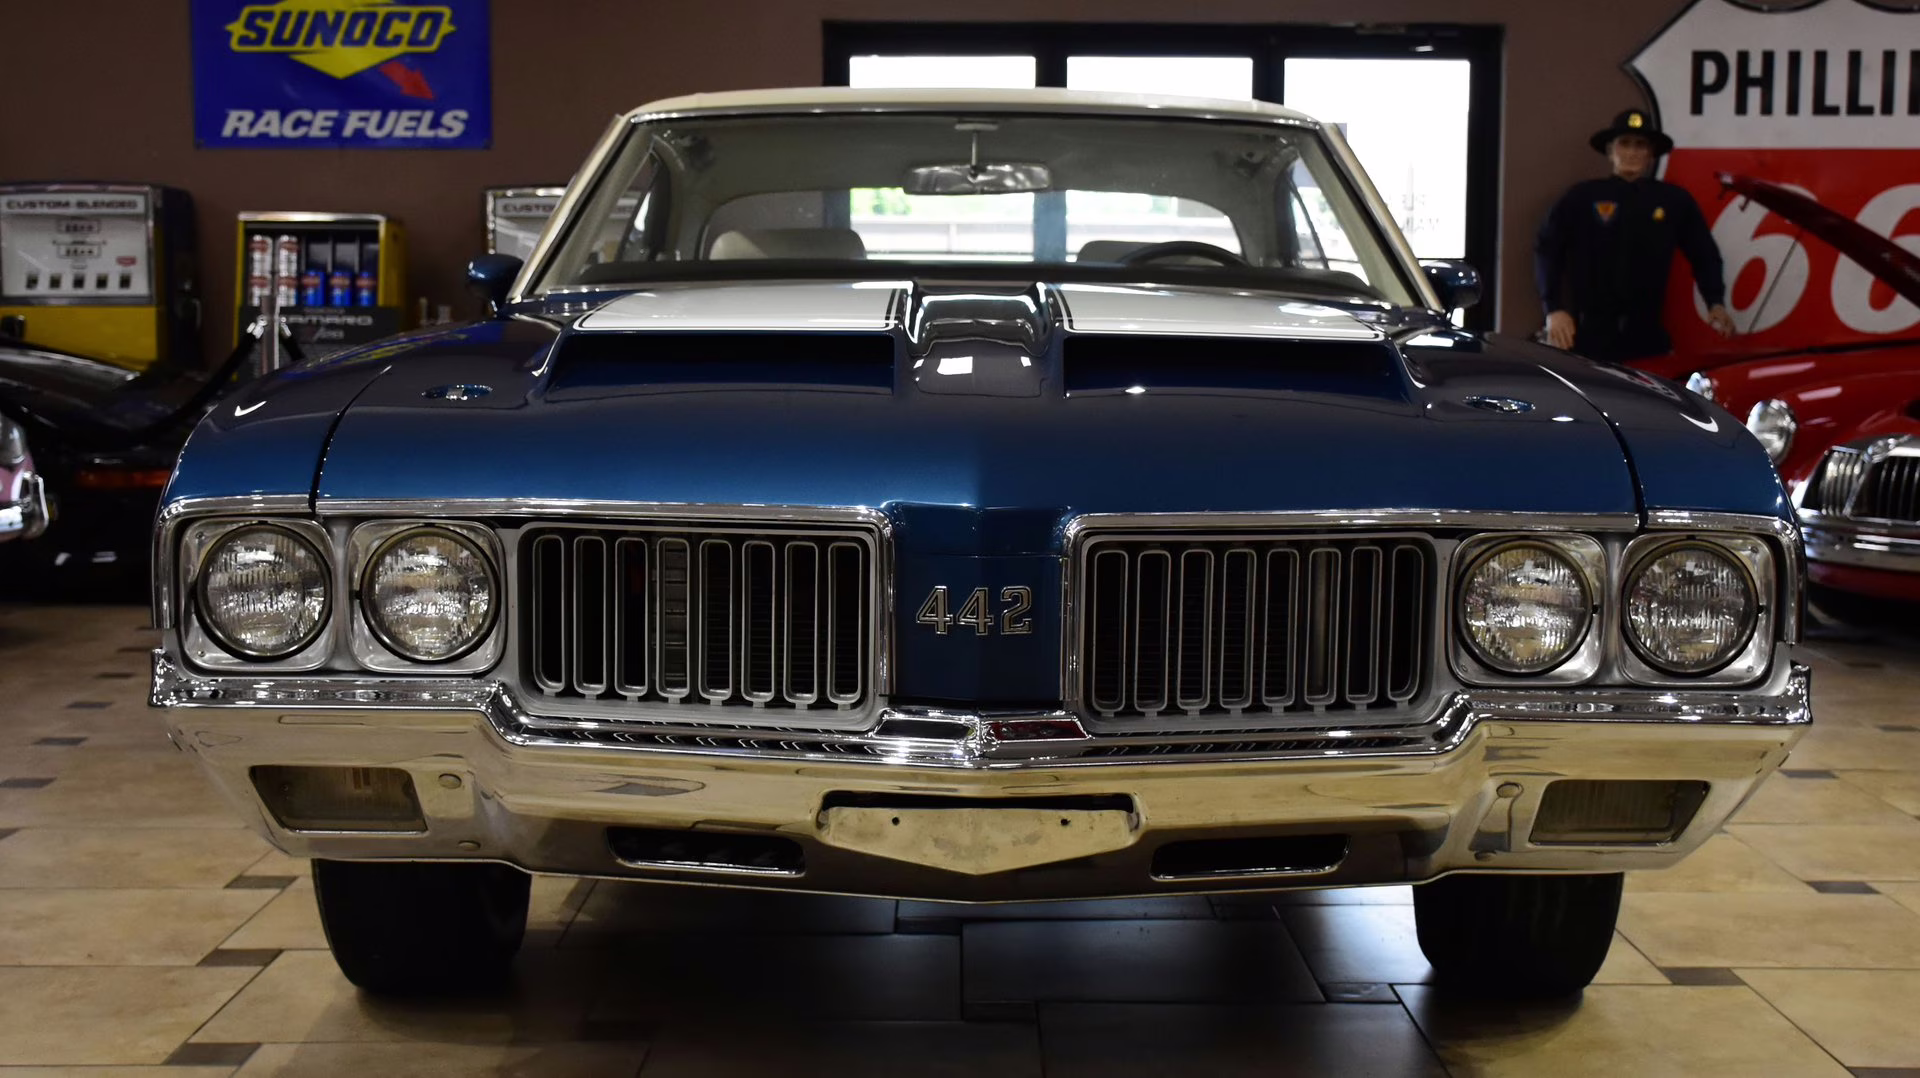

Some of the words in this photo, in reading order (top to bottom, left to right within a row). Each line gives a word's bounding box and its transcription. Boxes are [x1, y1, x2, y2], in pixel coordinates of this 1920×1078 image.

[235, 10, 444, 48] SUNOCO
[221, 110, 338, 138] RACE
[341, 110, 469, 138] FUELS
[7, 200, 71, 210] CUSTOM
[503, 202, 556, 213] CUSTO
[916, 585, 1032, 635] 442
